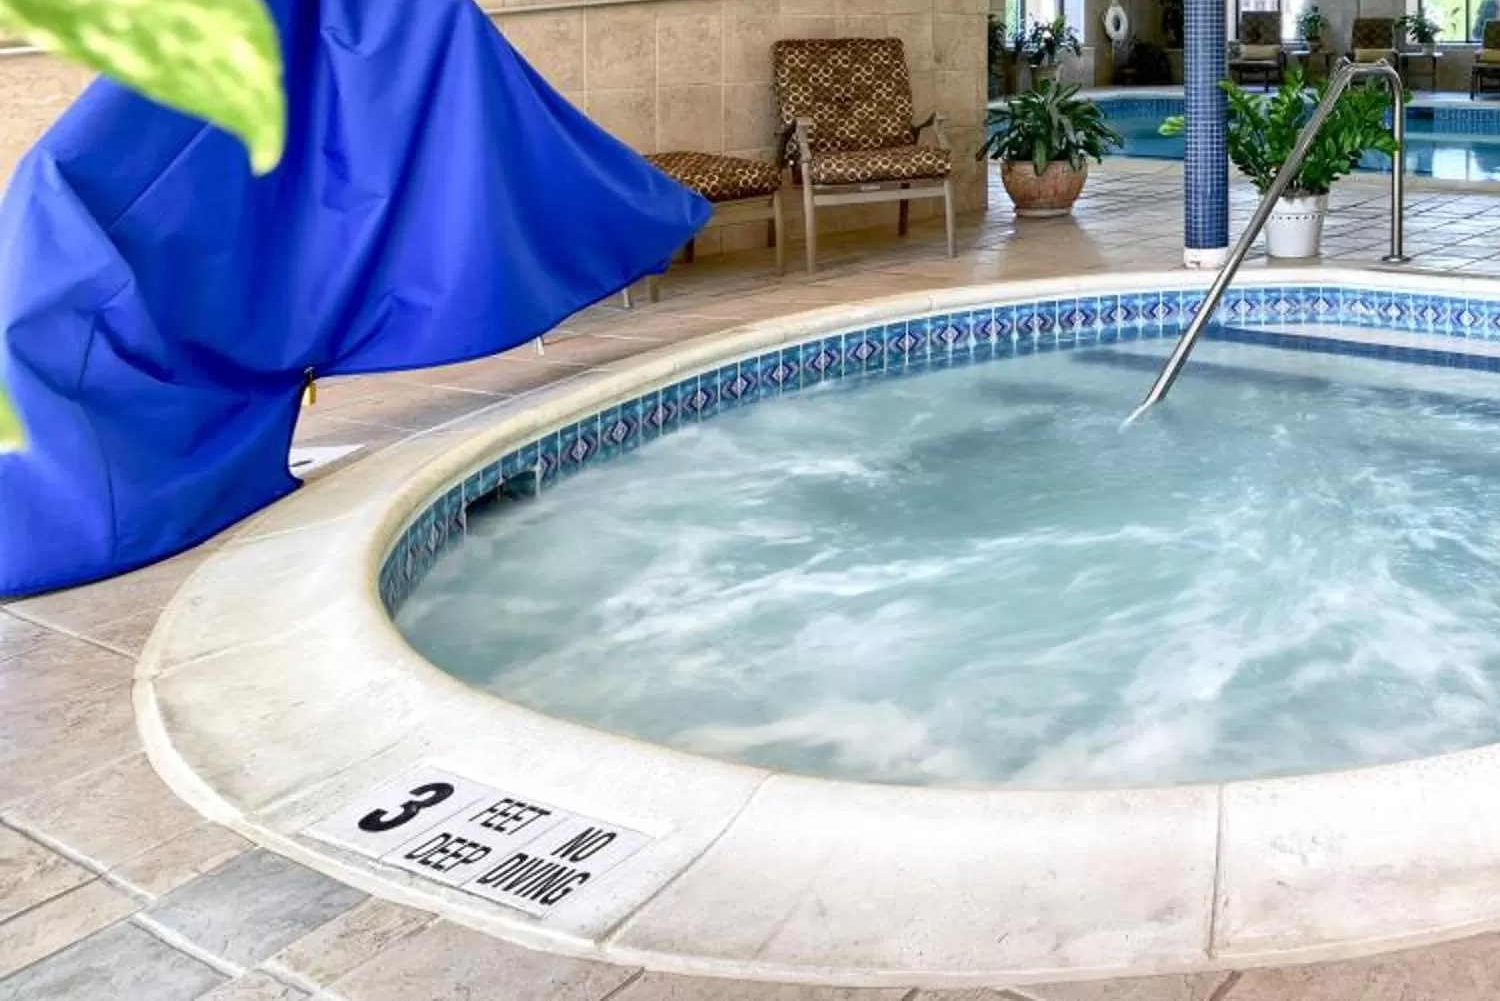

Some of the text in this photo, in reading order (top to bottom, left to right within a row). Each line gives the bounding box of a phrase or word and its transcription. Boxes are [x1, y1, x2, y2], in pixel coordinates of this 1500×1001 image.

[357, 782, 455, 833] 3
[469, 798, 552, 837] FEET
[403, 832, 492, 872] DEEP
[551, 826, 617, 862] NO
[476, 852, 591, 906] DIVING
